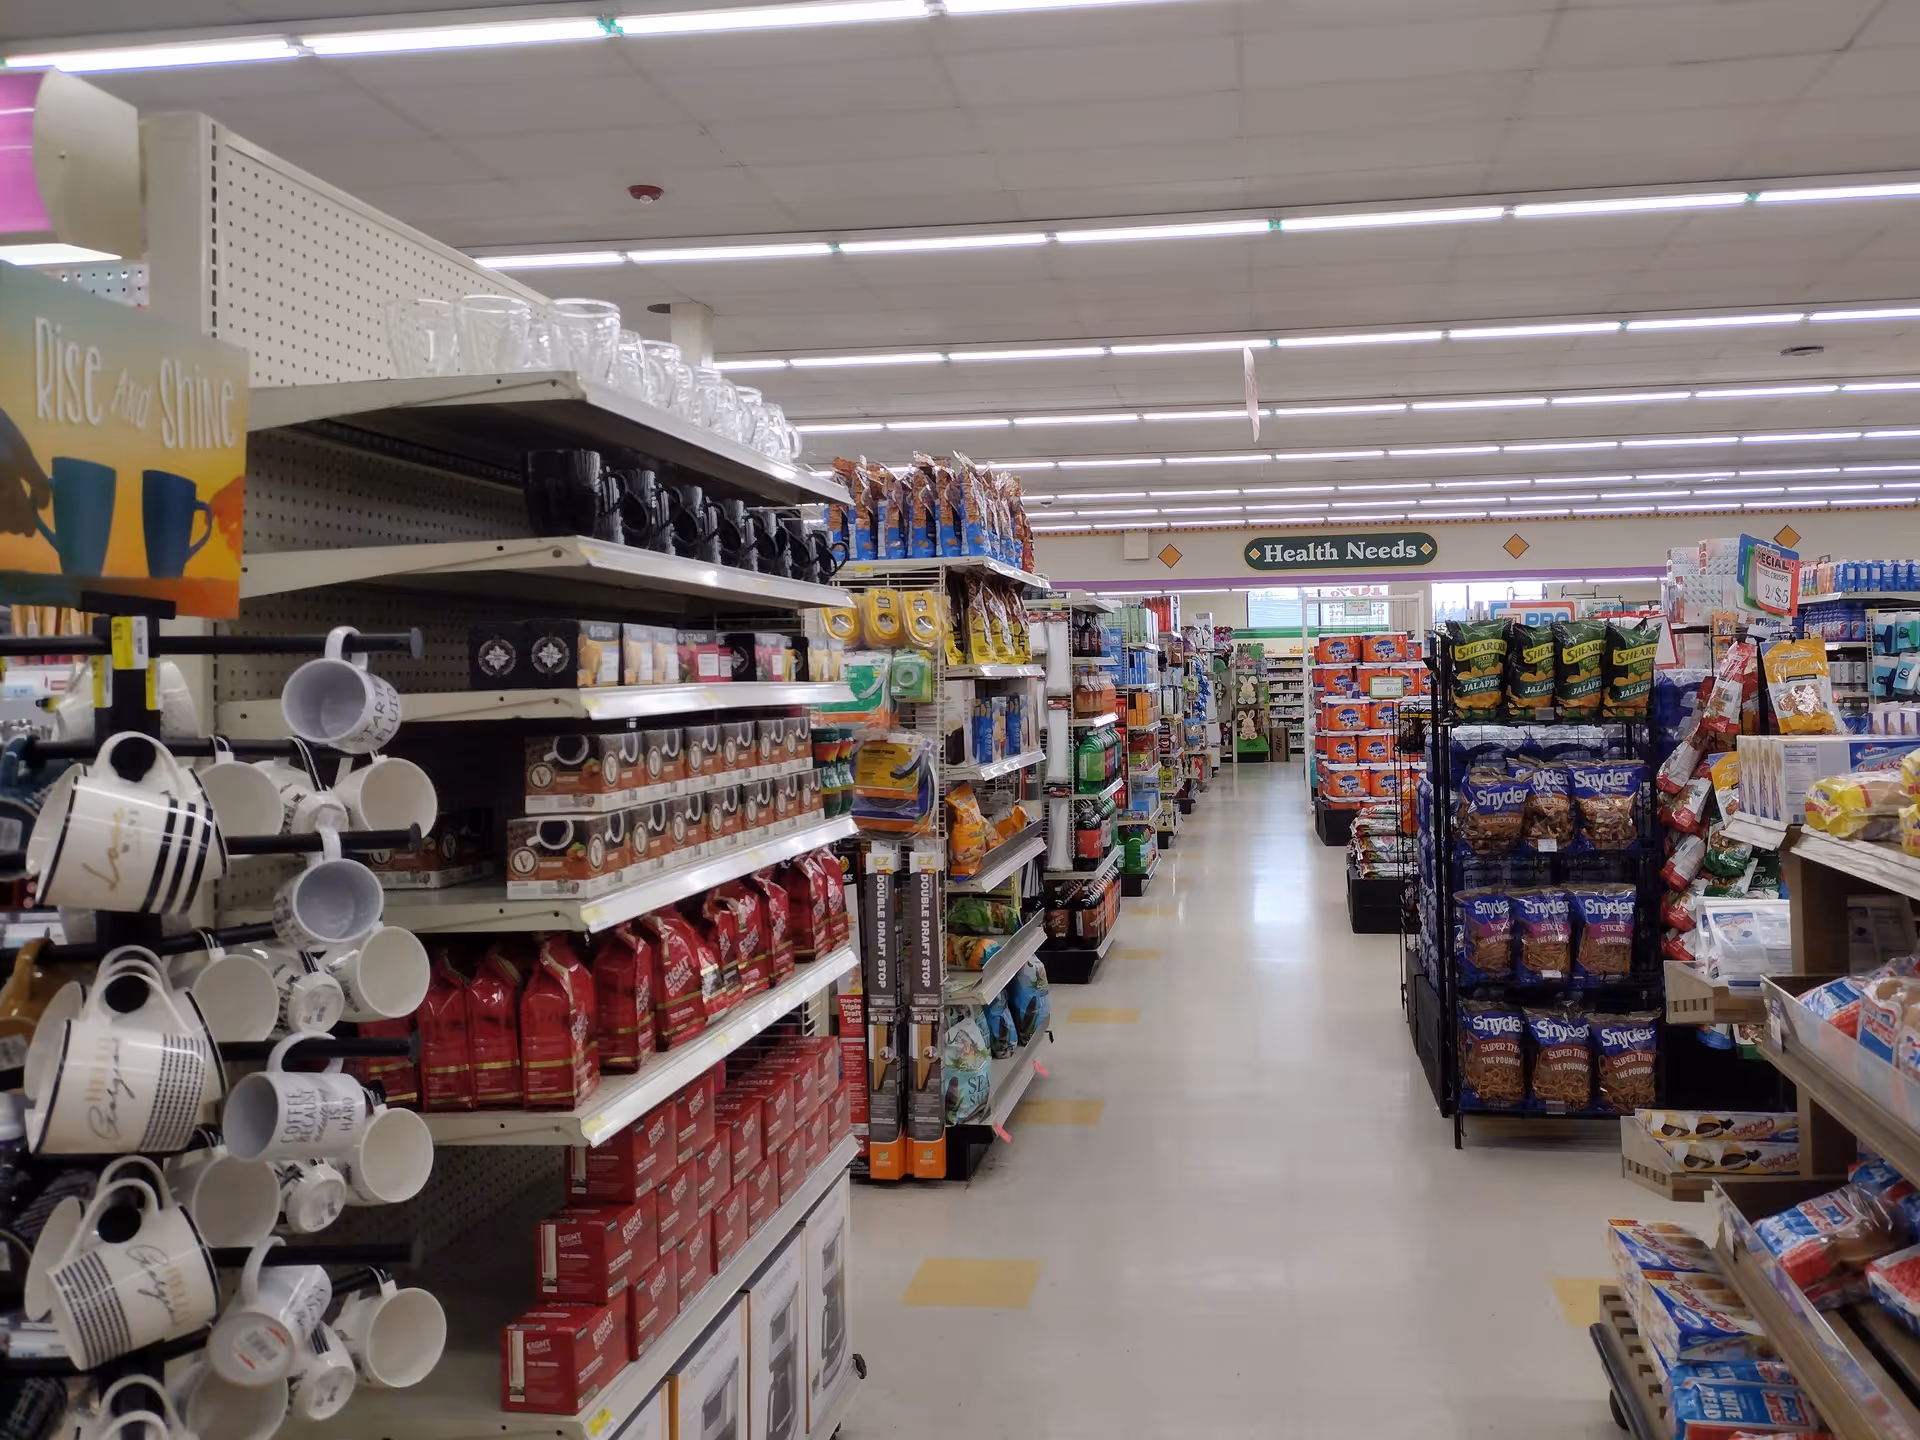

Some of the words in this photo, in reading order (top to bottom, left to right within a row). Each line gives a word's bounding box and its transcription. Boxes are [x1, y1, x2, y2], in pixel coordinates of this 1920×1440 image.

[35, 316, 103, 426] Rise
[1263, 541, 1339, 563] Health
[1345, 539, 1417, 560] Needs
[1764, 584, 1789, 604] 2/$5
[1574, 769, 1633, 791] Snyder
[1476, 788, 1530, 811] Snyder
[876, 874, 886, 918] DOUBLE
[920, 873, 930, 918] DOUBLE
[1524, 900, 1570, 920] Snyder
[1585, 899, 1635, 920] Snyder
[877, 921, 886, 956] DRAFT
[921, 920, 930, 956] DRAFT
[1600, 923, 1625, 933] STICKS
[665, 955, 690, 988] EIGHT
[877, 959, 887, 989] STOP
[922, 958, 931, 988] STOP
[841, 1003, 862, 1011] Triple
[923, 1014, 939, 1022] TOOLS
[846, 1016, 862, 1024] Seal
[1472, 1015, 1524, 1036] Snyder
[1536, 1019, 1590, 1042] Snyder
[1481, 1042, 1505, 1053] SUPER
[1601, 1026, 1655, 1049] Snyder
[1481, 1056, 1493, 1065] THE
[1547, 1048, 1572, 1060] SUPER
[1612, 1055, 1637, 1068] SUPER
[328, 1109, 341, 1120] IS
[339, 1097, 354, 1131] HARD
[622, 1208, 641, 1238] EIGHT
[593, 1310, 614, 1340] EIGHT
